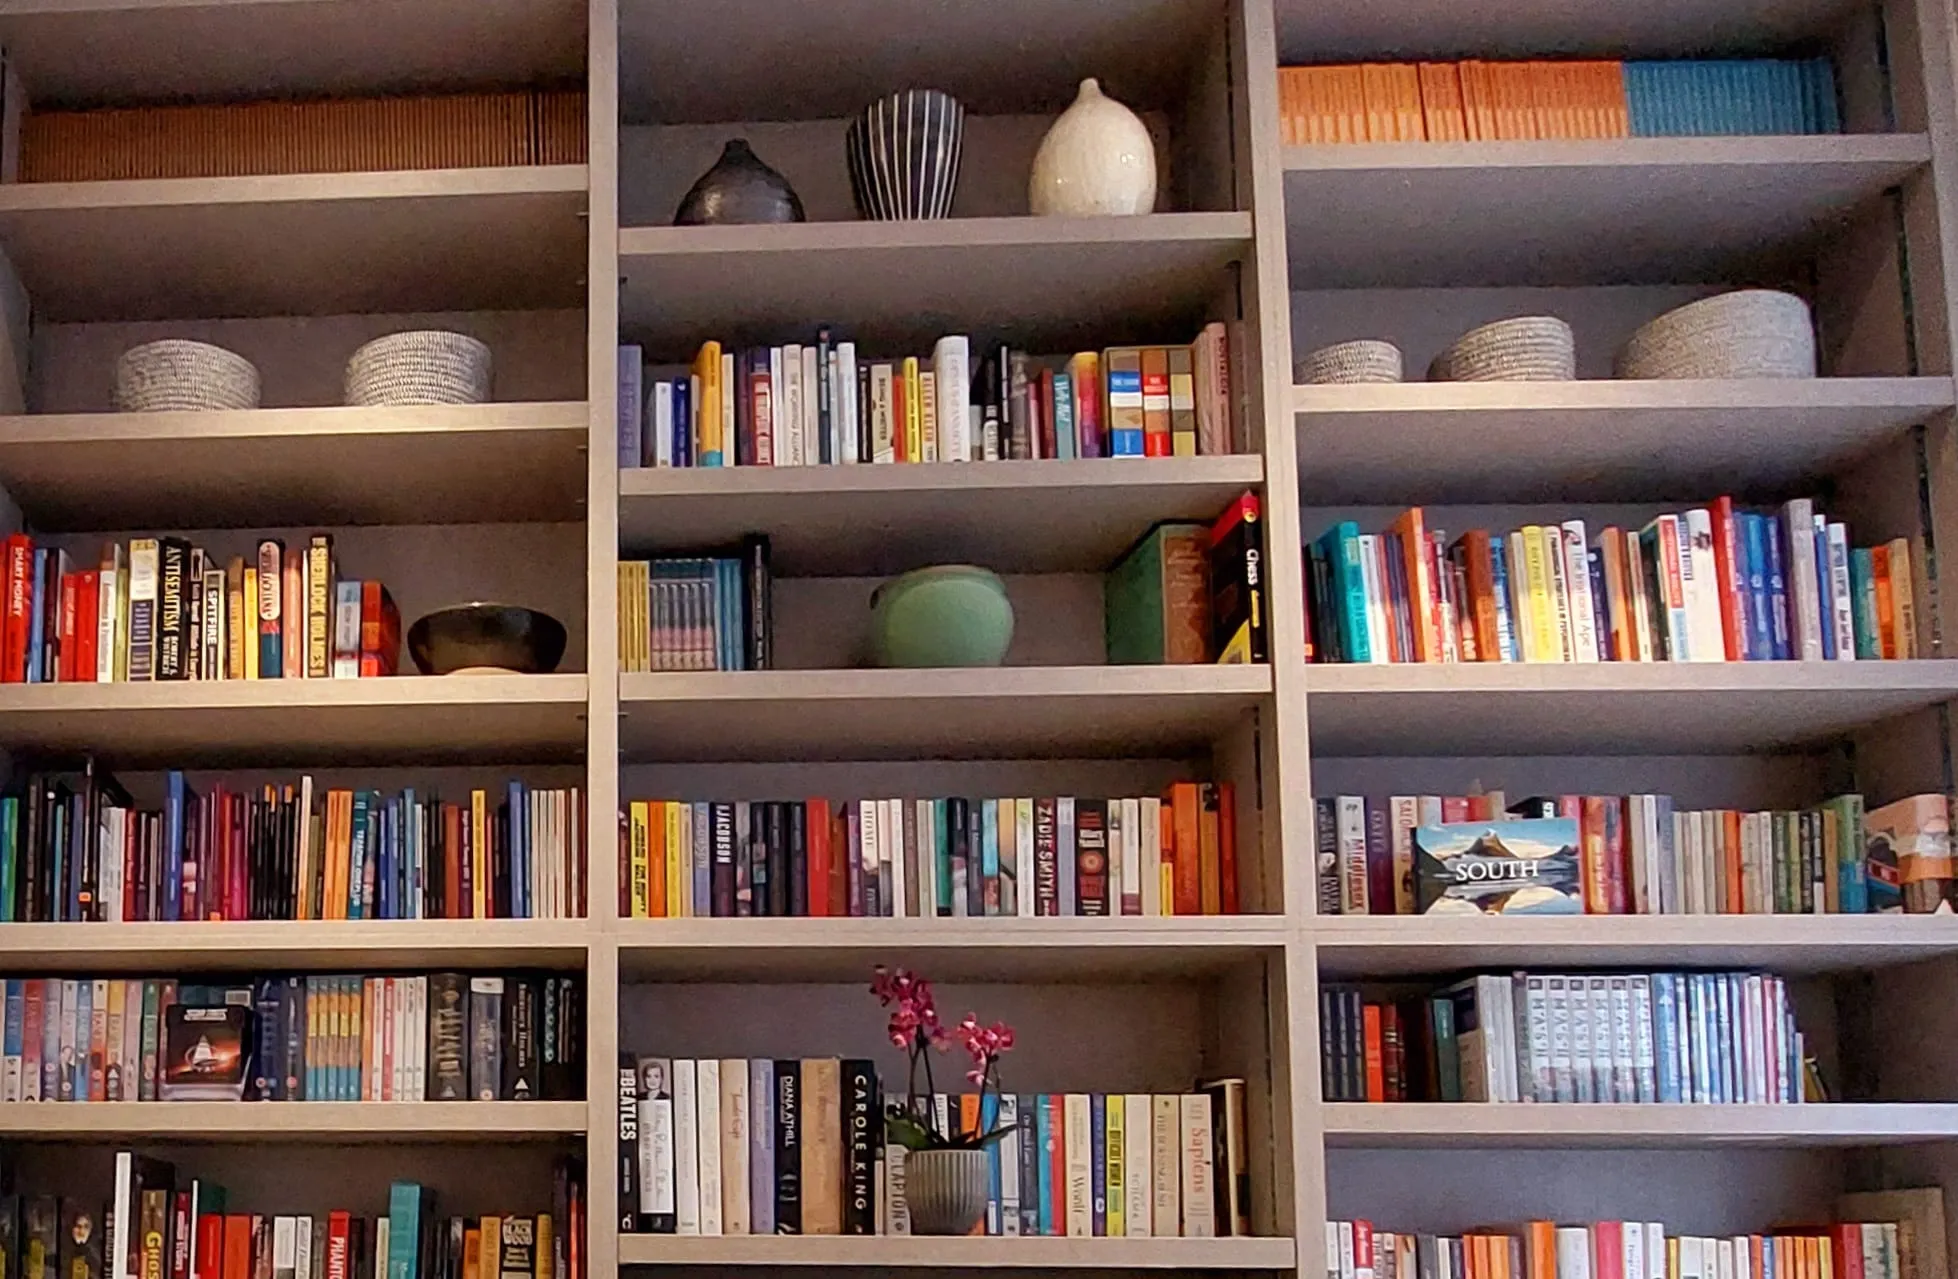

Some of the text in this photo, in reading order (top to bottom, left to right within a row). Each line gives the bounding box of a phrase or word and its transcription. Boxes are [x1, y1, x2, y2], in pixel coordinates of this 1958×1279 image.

[880, 411, 888, 440] WRITER
[163, 546, 182, 632] ANTISEMITISM
[310, 547, 328, 614] SHERLOCK
[1246, 549, 1259, 585] Chess
[1574, 552, 1584, 571] The
[1579, 625, 1591, 647] Ape
[207, 590, 218, 645] SPITFIRE
[716, 811, 731, 863] JACOBSON
[863, 810, 874, 849] HOME
[1037, 806, 1054, 898] ZADIE SMITH
[1351, 839, 1366, 909] Middlesex
[1455, 859, 1539, 881] SOUTH
[620, 1078, 636, 1140] BEATLES
[784, 1076, 795, 1147] DIANA ATHILL
[855, 1075, 867, 1210] CAROLE KING
[1187, 1128, 1208, 1193] Sapiens
[890, 1154, 906, 1219] CLAPTON
[1072, 1176, 1085, 1215] Woolf
